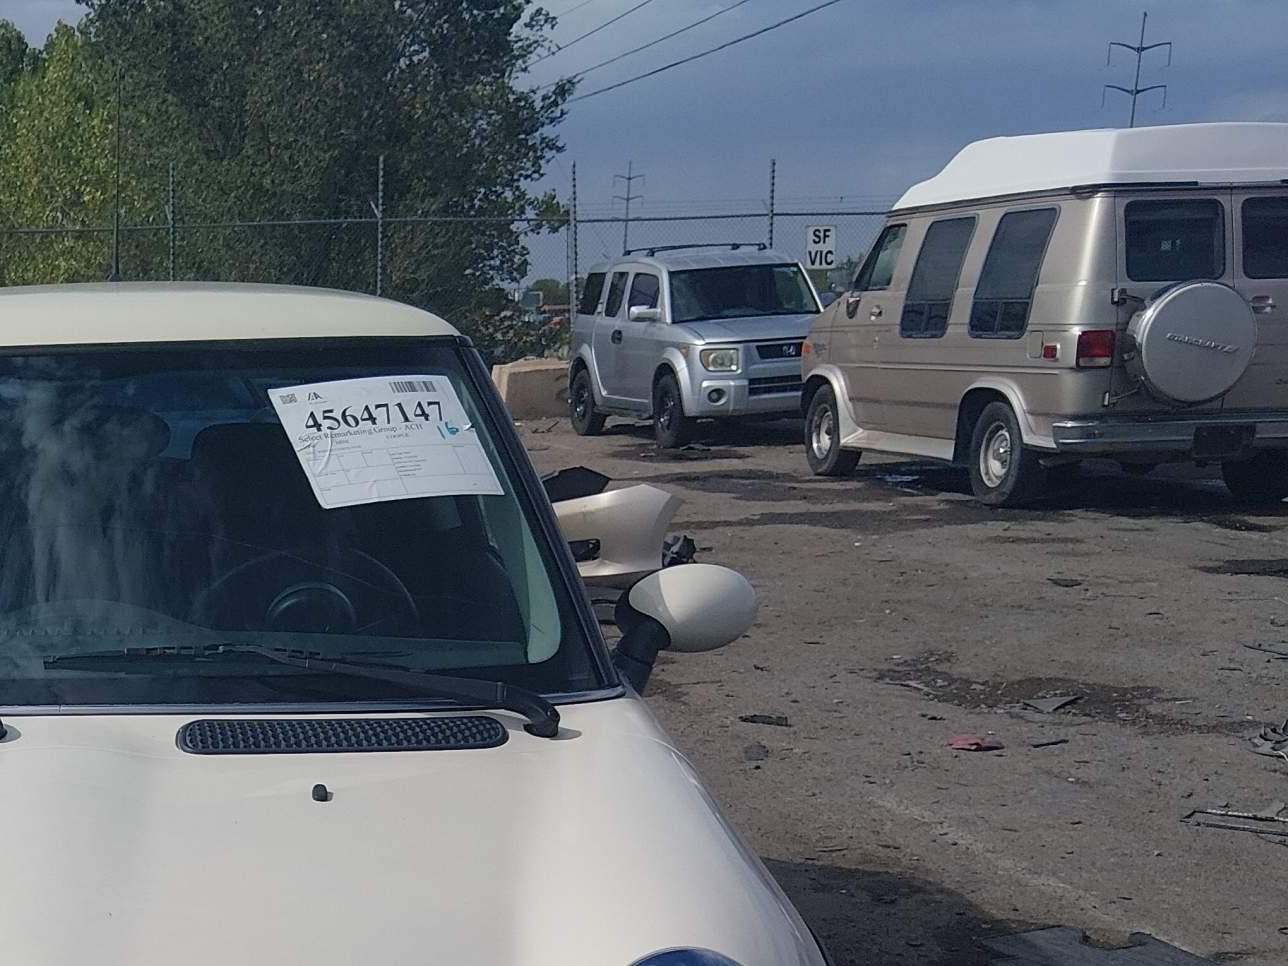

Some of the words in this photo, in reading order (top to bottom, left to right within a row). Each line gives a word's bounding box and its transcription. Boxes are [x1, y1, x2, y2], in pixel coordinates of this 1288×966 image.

[812, 228, 832, 245] SF
[808, 250, 834, 266] VIC
[305, 401, 443, 432] 45647147
